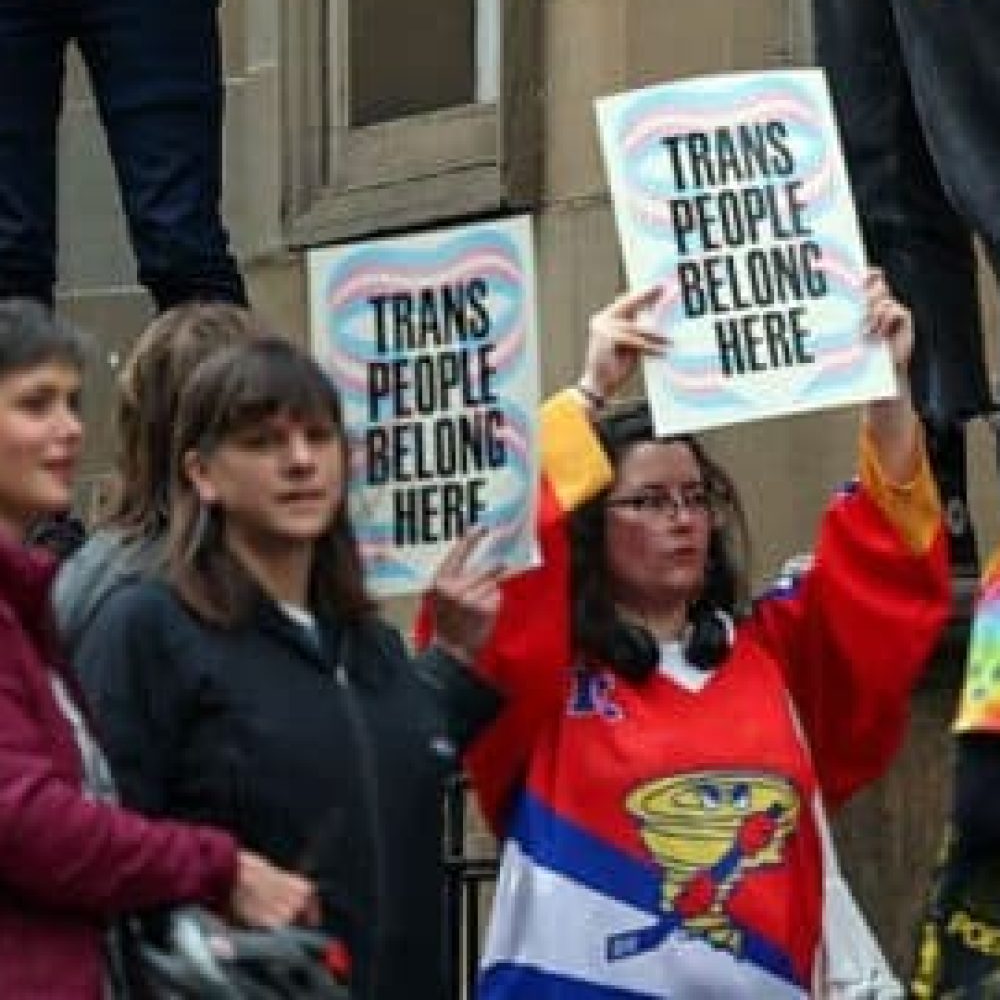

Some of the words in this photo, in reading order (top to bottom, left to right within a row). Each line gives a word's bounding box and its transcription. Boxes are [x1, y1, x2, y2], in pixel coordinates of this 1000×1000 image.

[660, 121, 794, 190] TRANS
[671, 181, 813, 255] PEOPLE
[367, 277, 489, 352] TRANS
[677, 241, 827, 318] BELONG
[714, 307, 815, 375] HERE
[367, 344, 497, 422] PEOPLE
[366, 410, 506, 486] BELONG
[393, 479, 488, 547] HERE
